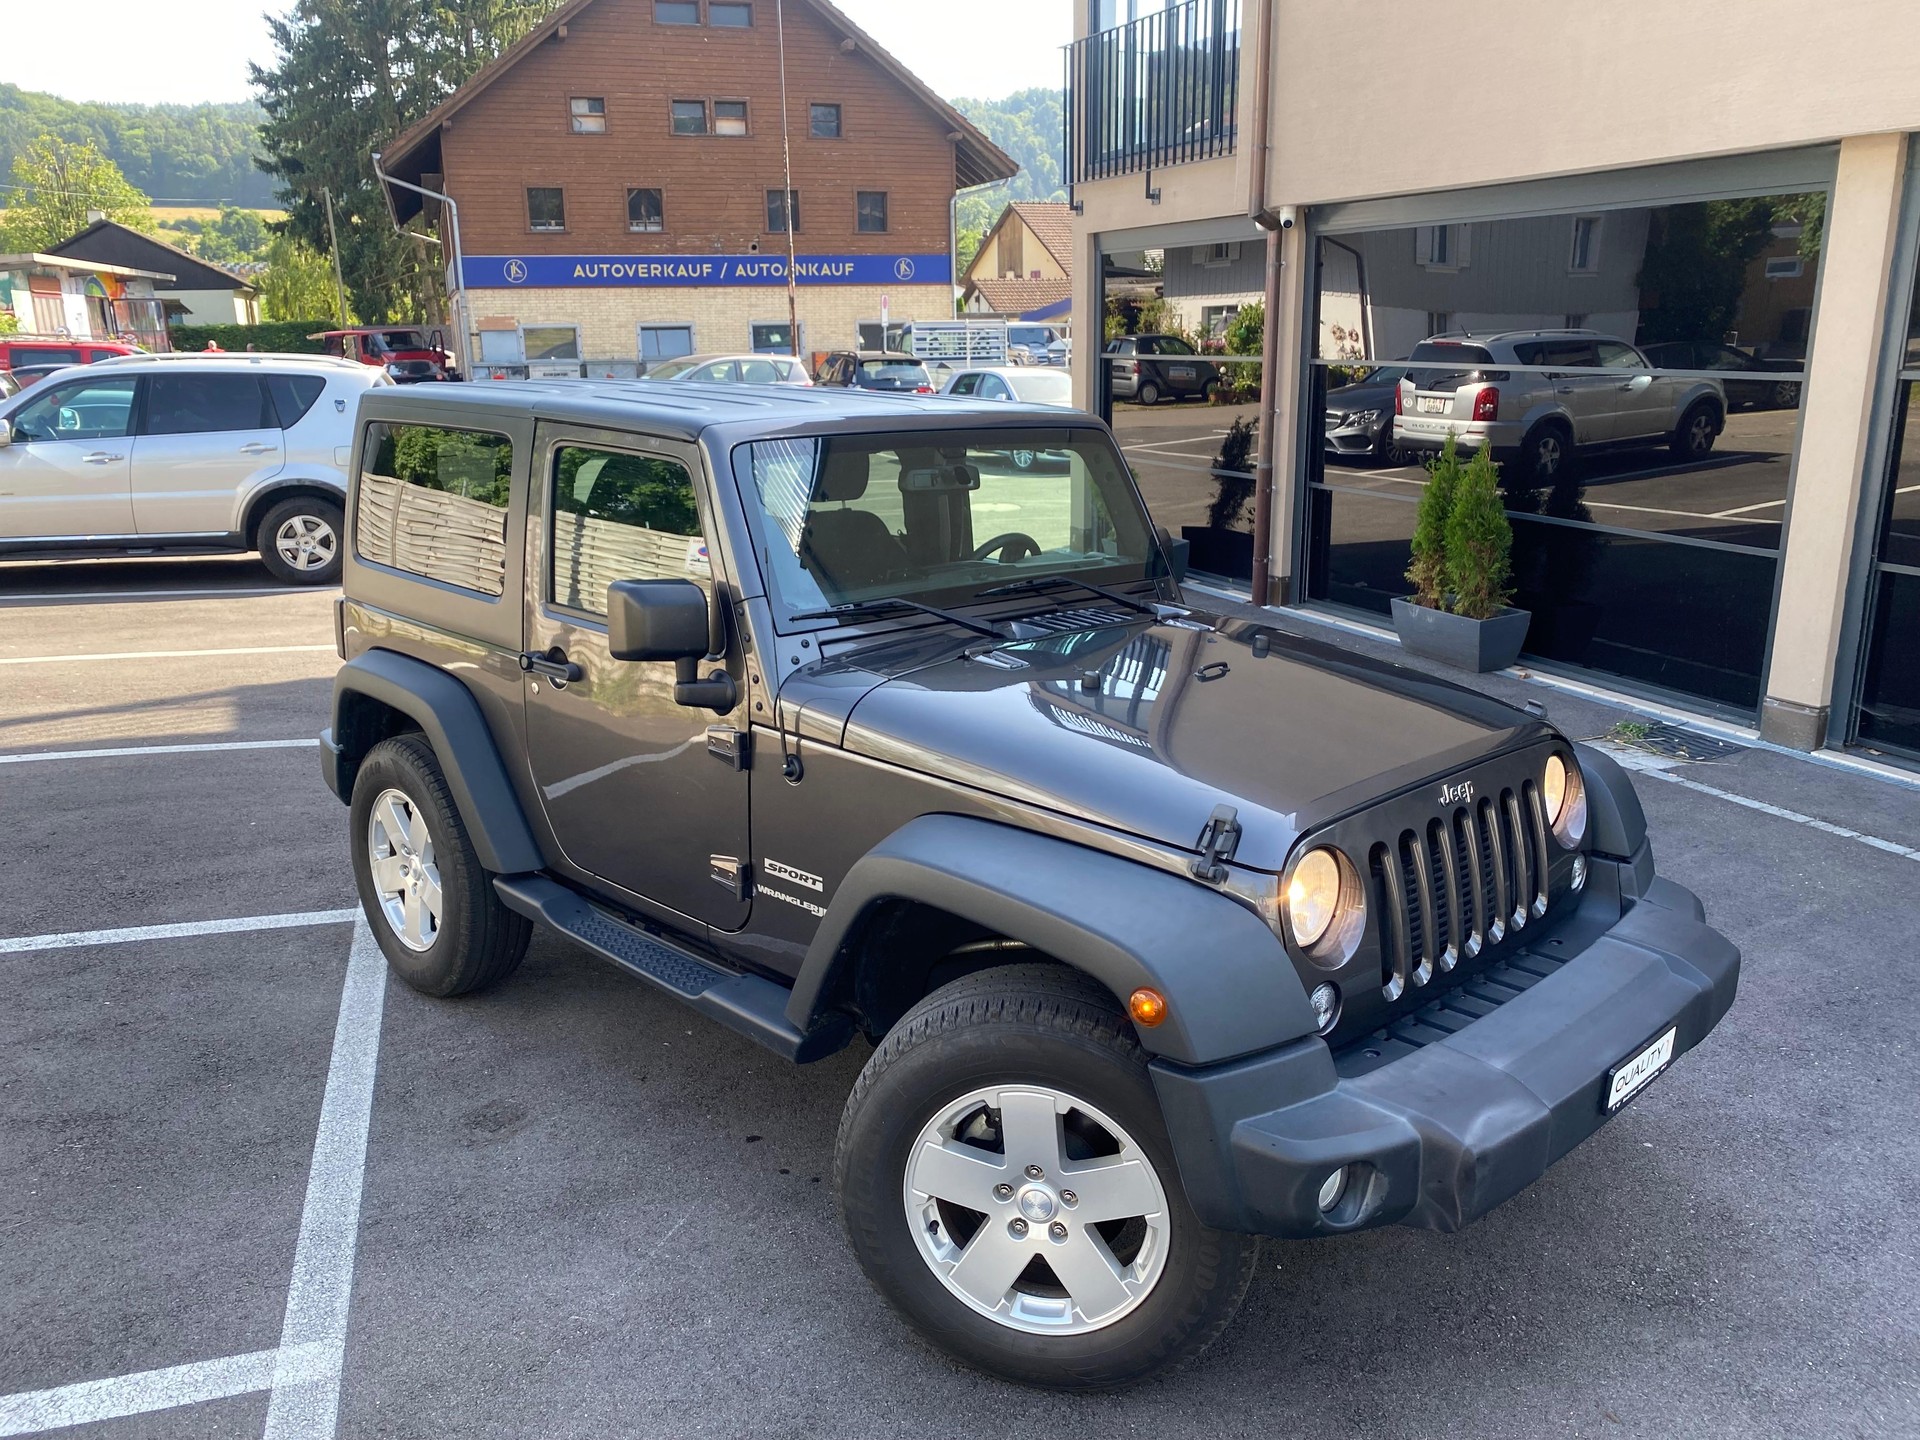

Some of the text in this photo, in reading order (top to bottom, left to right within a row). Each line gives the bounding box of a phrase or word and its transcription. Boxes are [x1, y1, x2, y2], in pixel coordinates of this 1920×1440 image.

[573, 263, 713, 278] AUTOVERKAUF
[1438, 780, 1474, 807] Jeep
[767, 862, 821, 887] SPORT
[757, 883, 819, 914] WRANGLER
